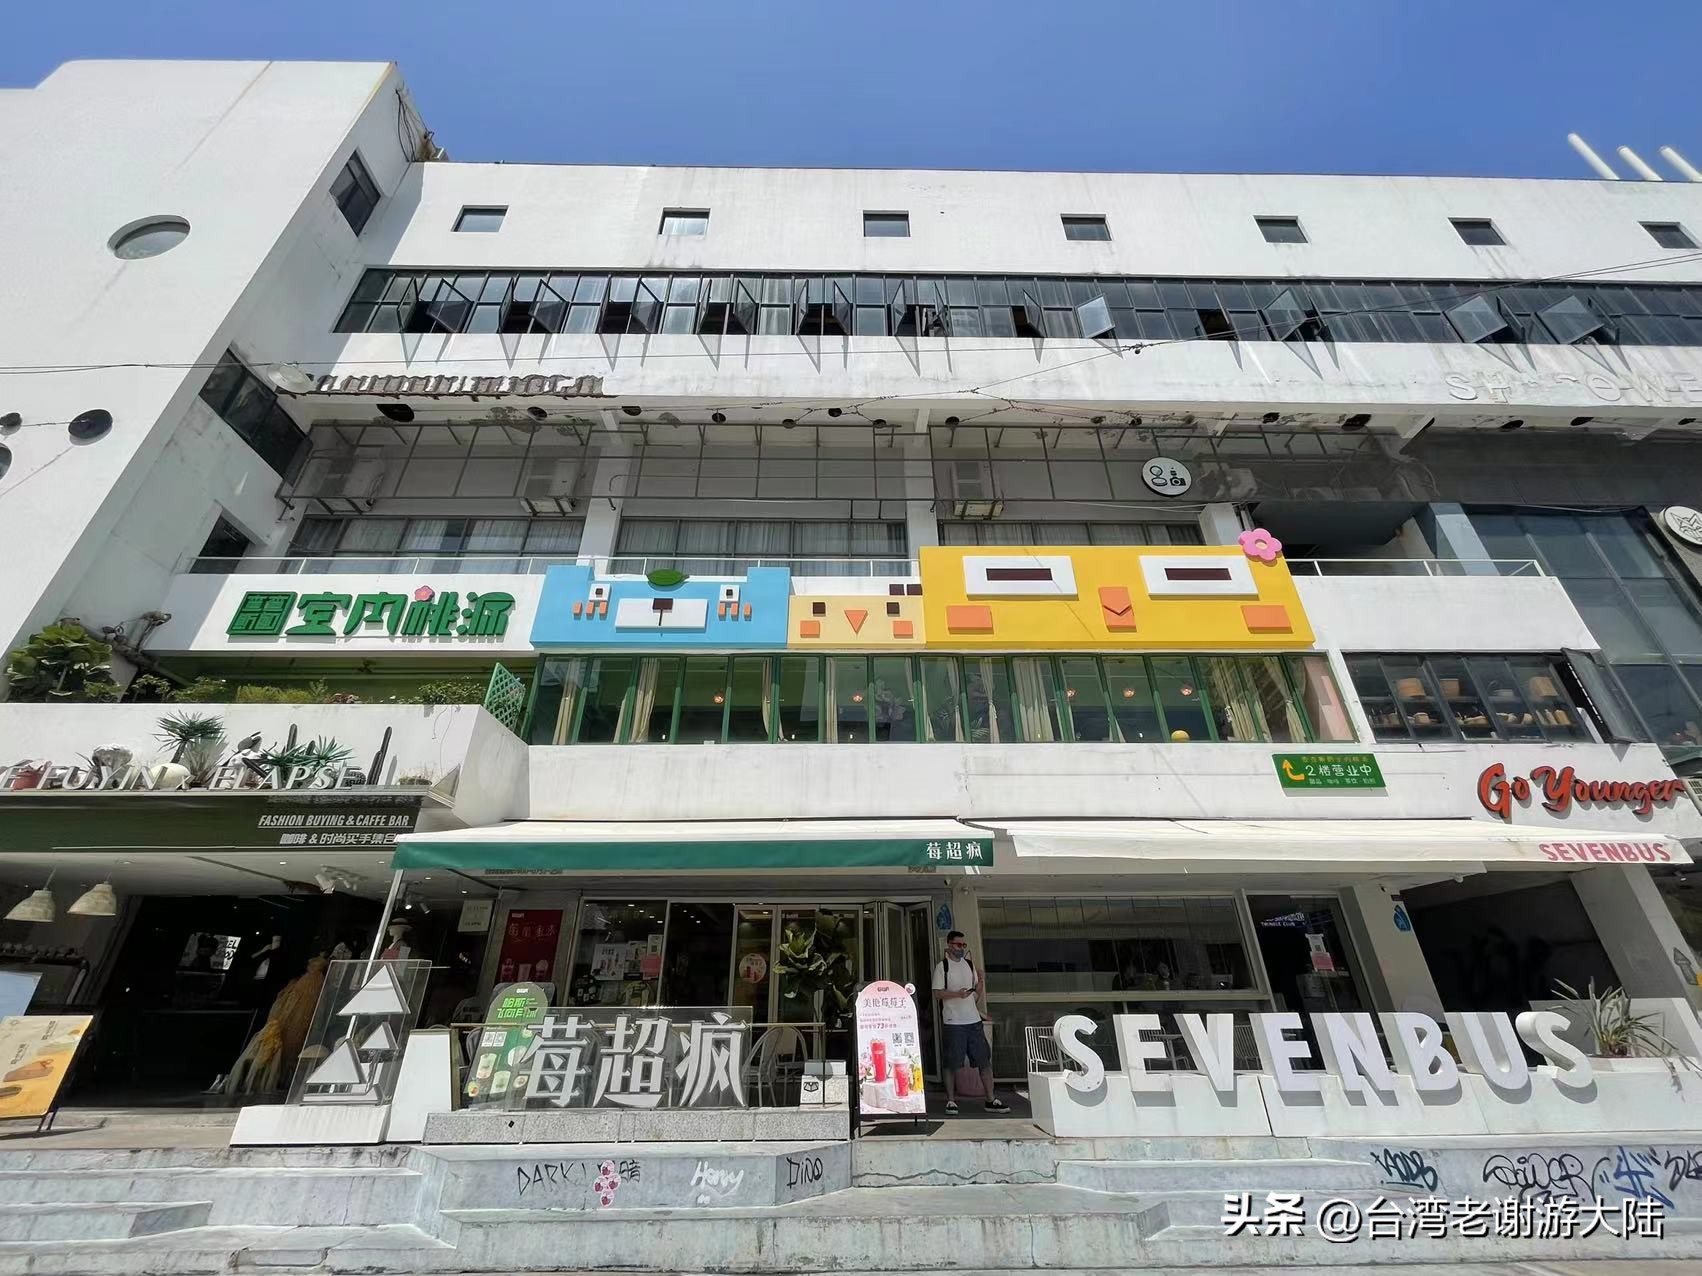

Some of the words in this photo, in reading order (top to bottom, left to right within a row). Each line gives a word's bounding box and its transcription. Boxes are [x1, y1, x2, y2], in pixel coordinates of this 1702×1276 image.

[285, 587, 516, 636] 室内桃源
[37, 765, 169, 790] FUYIN
[209, 764, 362, 790] ELAPSE
[1477, 762, 1530, 818] Go
[1530, 765, 1686, 815] Younger
[258, 814, 303, 826] FASHION
[306, 815, 344, 826] BUYING
[356, 815, 387, 826] CAFFE
[388, 815, 409, 826] BAR
[279, 833, 308, 845] 咖啡
[926, 841, 984, 860] 莓超疯
[1538, 842, 1671, 862] SEVENBUS
[521, 1012, 747, 1108] 莓超疯
[1053, 1011, 1597, 1093] SEVENBUS
